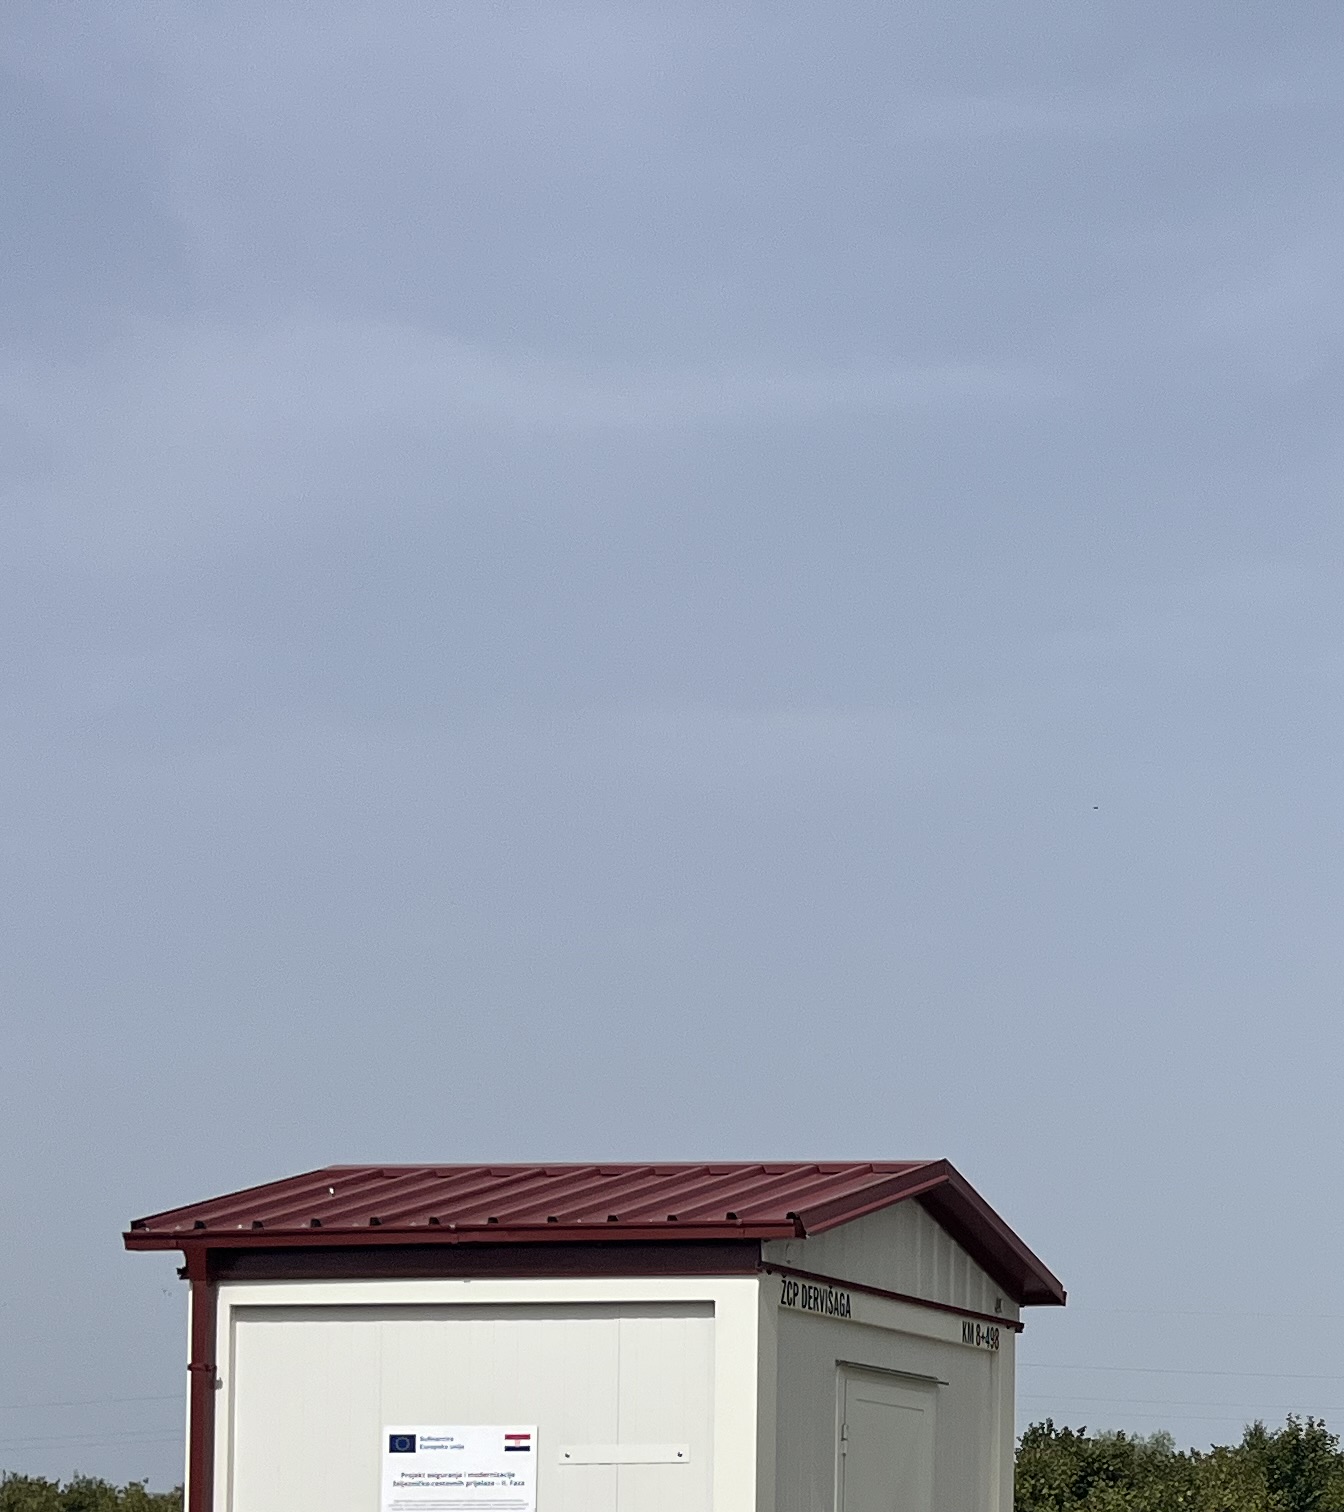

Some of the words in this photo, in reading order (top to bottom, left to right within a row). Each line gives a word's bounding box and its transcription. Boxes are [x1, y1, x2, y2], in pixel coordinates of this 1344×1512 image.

[781, 1274, 799, 1307] ŽCP
[801, 1284, 851, 1319] DERVIŠAGA
[962, 1321, 974, 1344] KM
